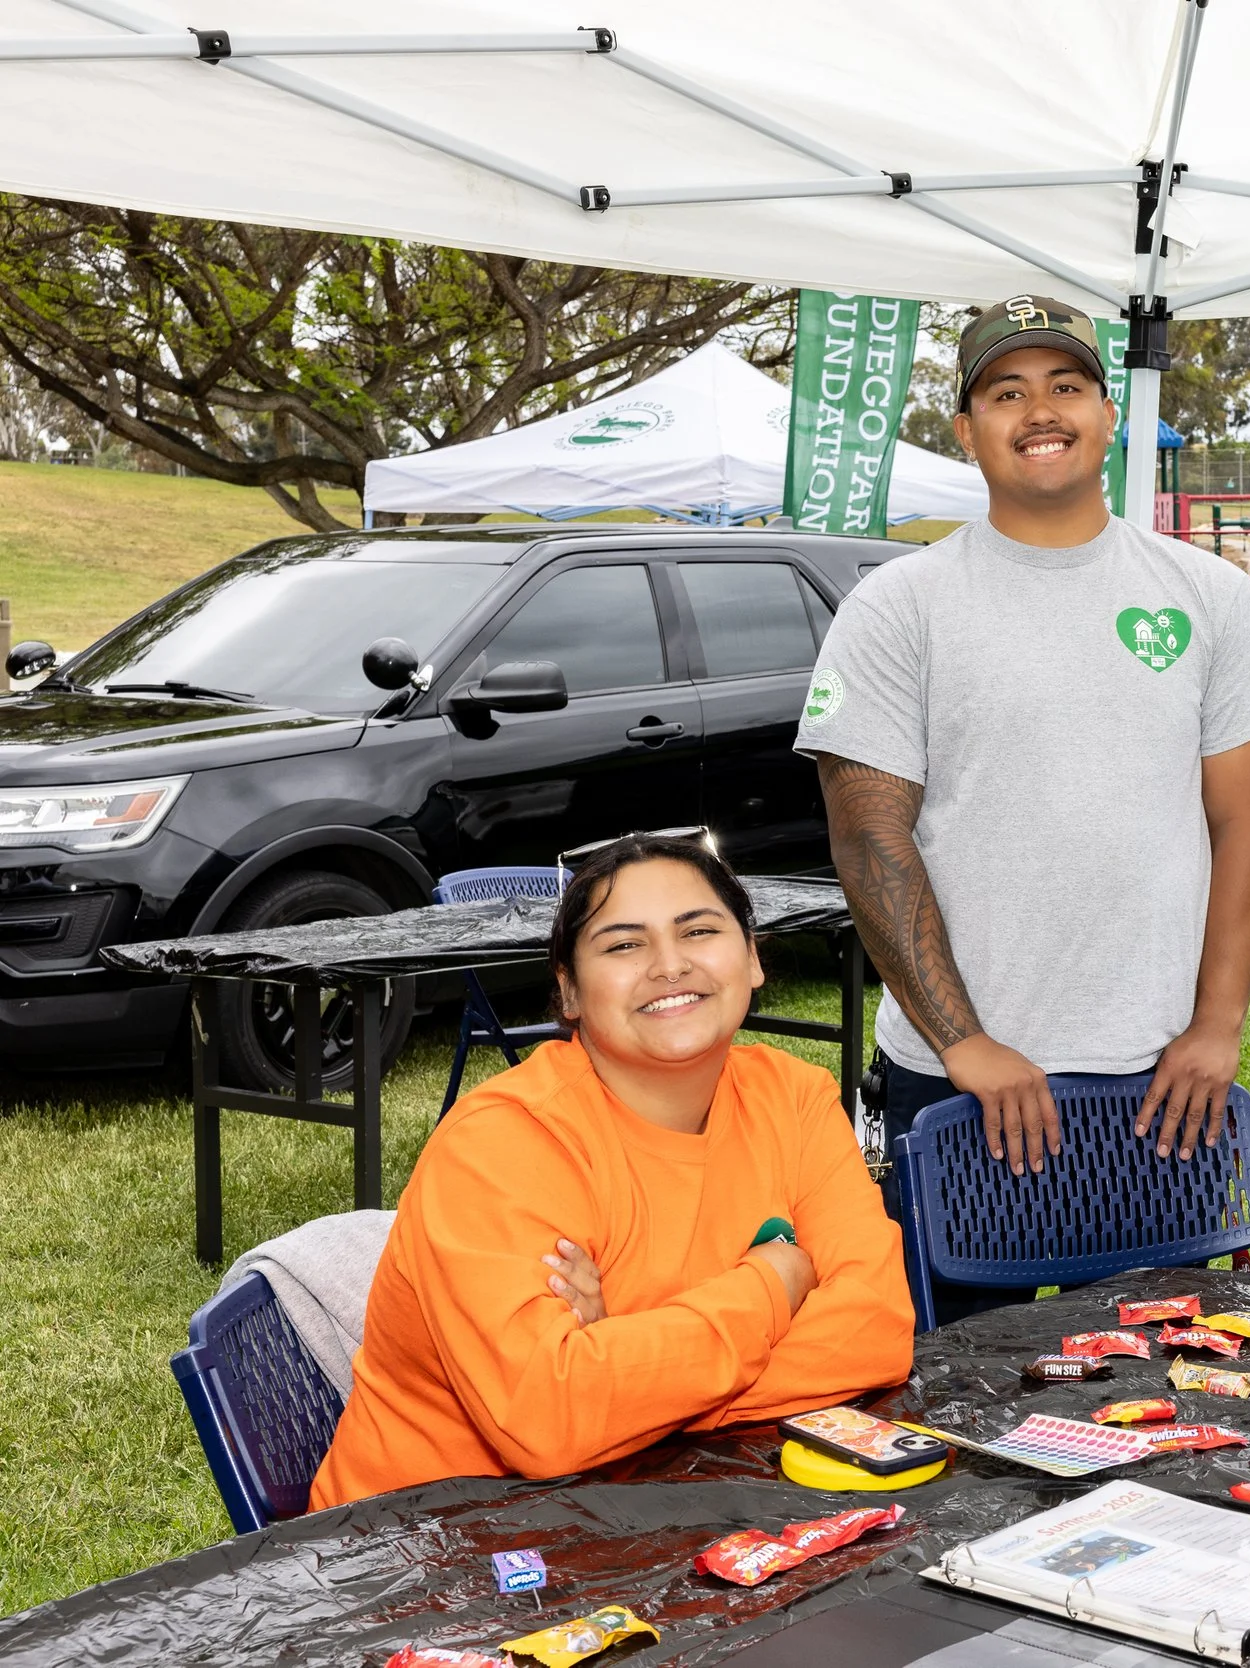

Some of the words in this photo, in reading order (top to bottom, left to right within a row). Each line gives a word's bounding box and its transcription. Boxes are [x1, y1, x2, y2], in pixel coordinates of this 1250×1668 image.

[1005, 296, 1049, 331] SD
[858, 298, 900, 441] DIEGO
[798, 292, 858, 533] UNDATION
[842, 451, 884, 536] PAR
[1044, 1364, 1062, 1376] FUN
[1063, 1364, 1082, 1376] SIZE
[1150, 1427, 1199, 1443] Twizzlers
[1037, 1508, 1103, 1537] Summer
[1103, 1490, 1144, 1511] 2025
